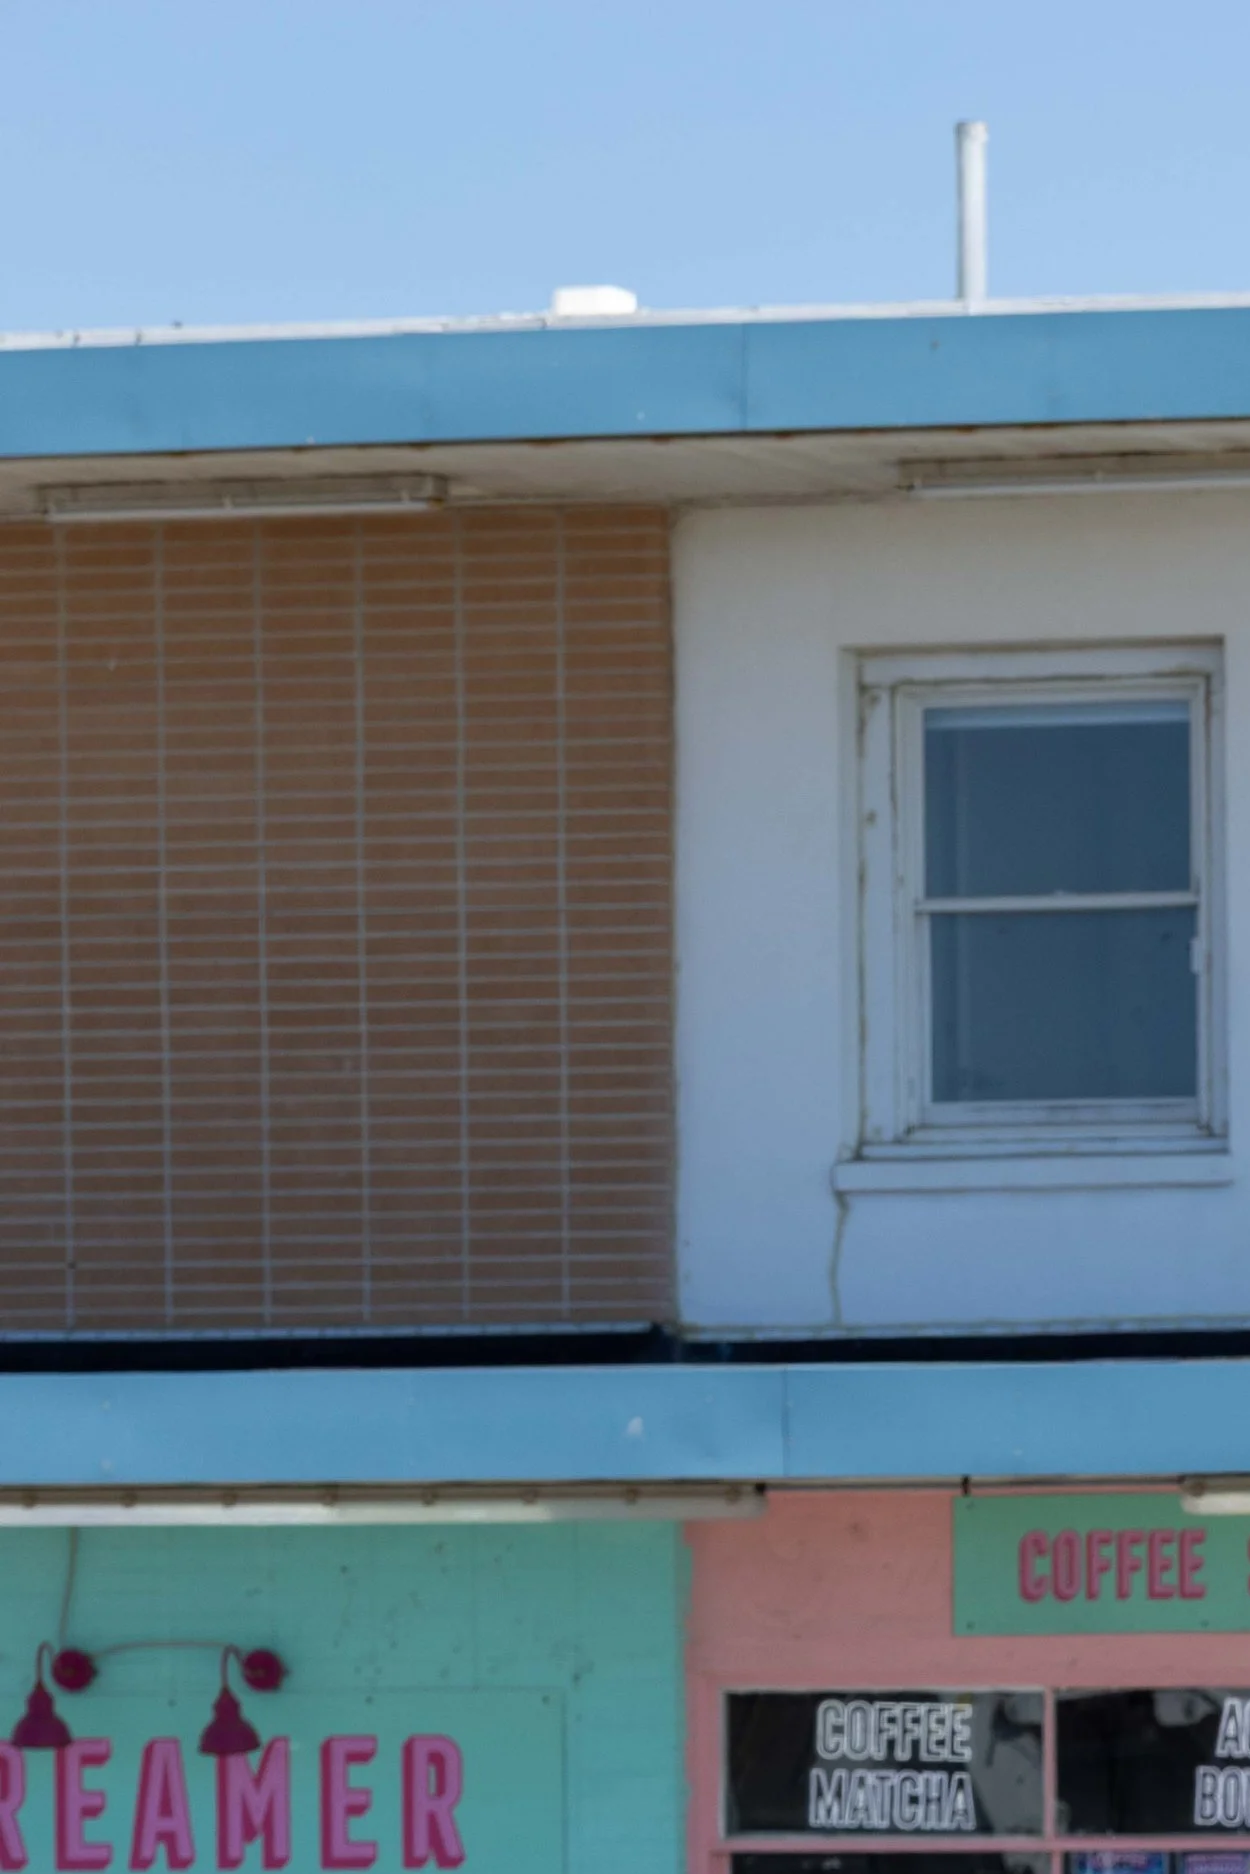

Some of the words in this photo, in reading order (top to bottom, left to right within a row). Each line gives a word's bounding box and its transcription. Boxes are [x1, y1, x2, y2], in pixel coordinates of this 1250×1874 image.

[1018, 1528, 1207, 1602] COFFEE
[815, 1699, 973, 1763] COFFEE
[808, 1768, 977, 1831] MATCHA
